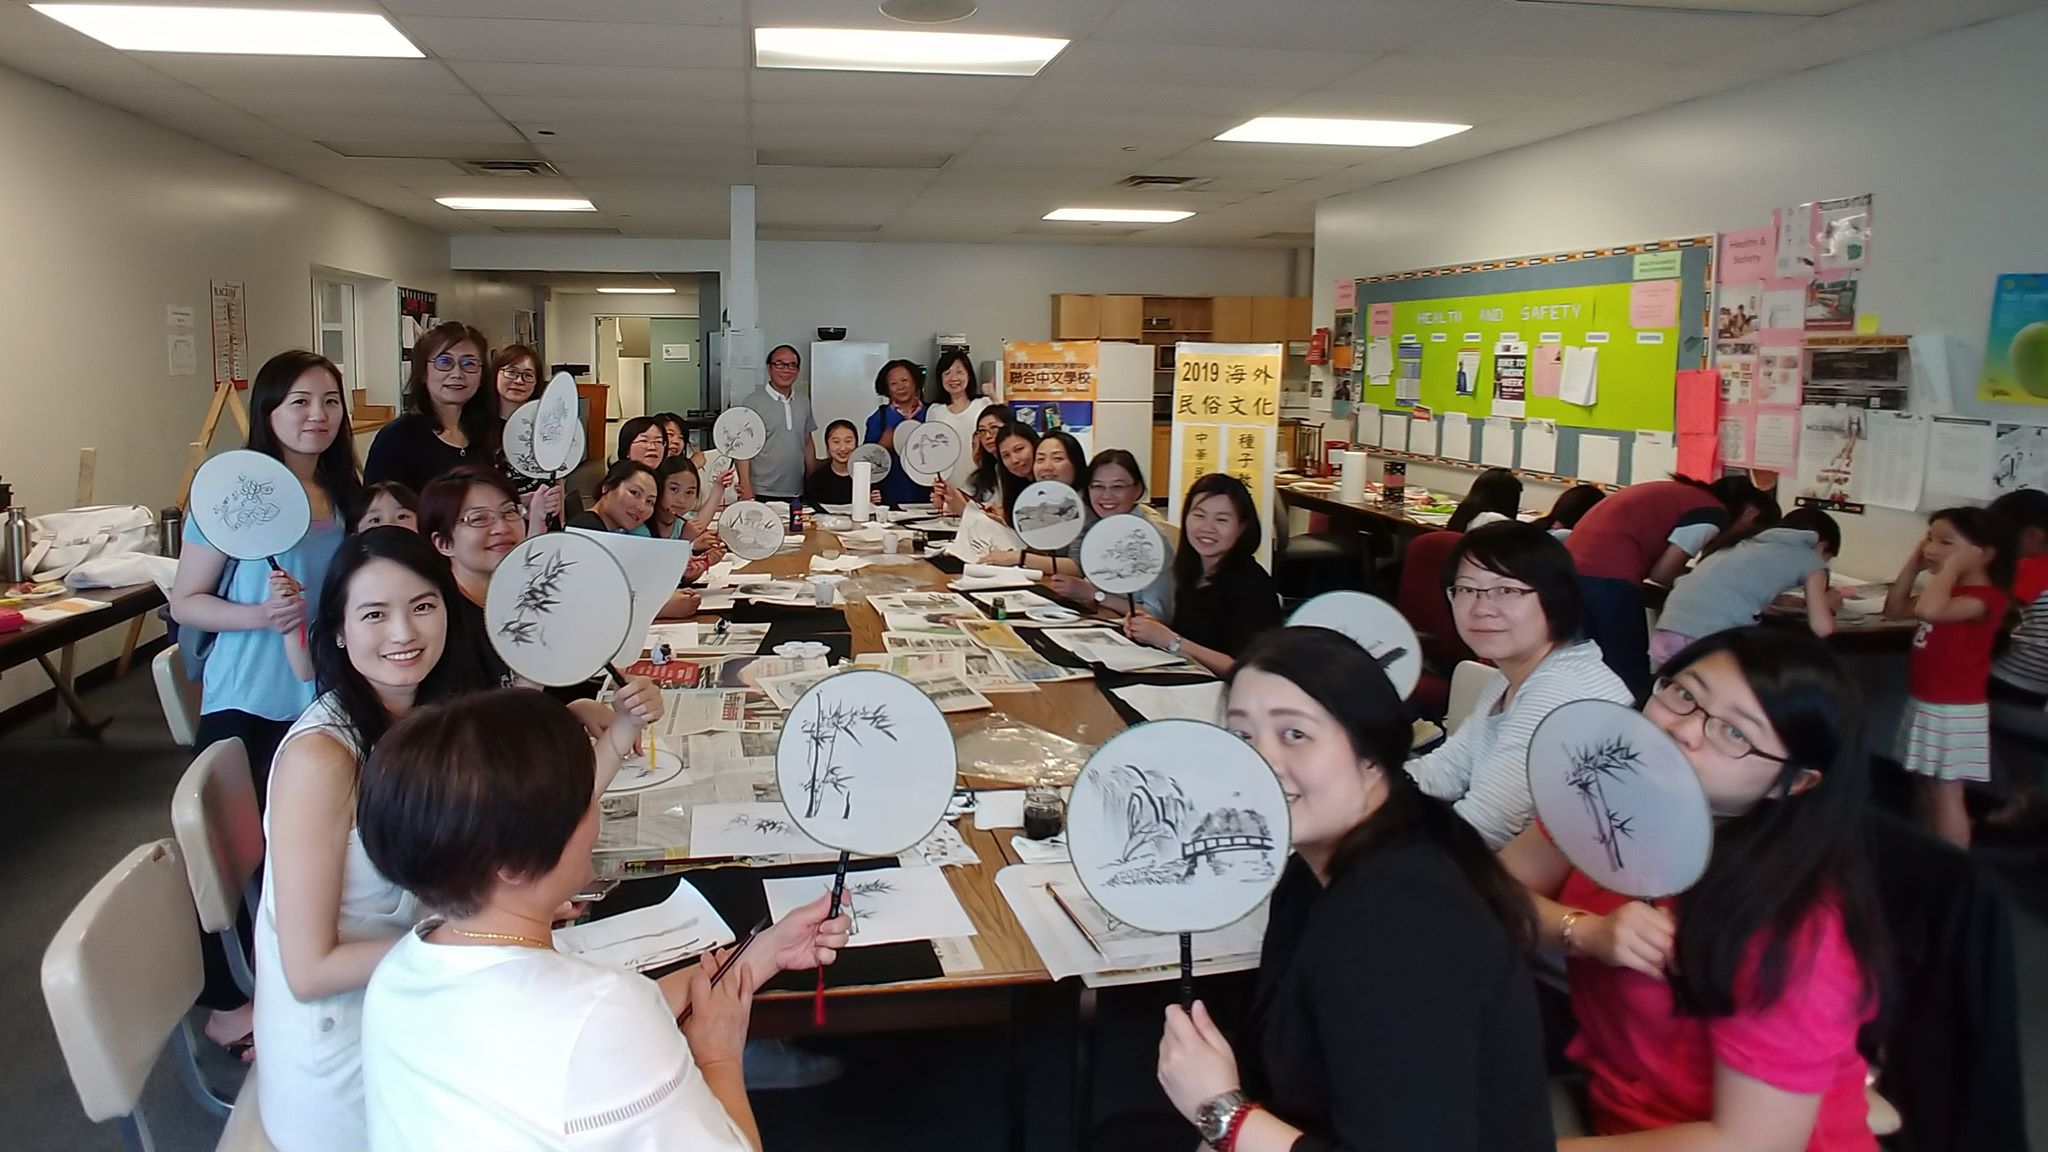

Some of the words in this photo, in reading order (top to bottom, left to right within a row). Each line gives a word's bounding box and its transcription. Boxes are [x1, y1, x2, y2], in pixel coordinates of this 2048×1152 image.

[1416, 310, 1462, 325] HEALTH
[1479, 307, 1504, 322] AND
[1520, 303, 1582, 321] SAFETY
[1009, 370, 1092, 385] 聯合中文學校
[1182, 362, 1219, 383] 2019
[1225, 364, 1274, 386] 海外
[1177, 394, 1275, 416] 民俗文化
